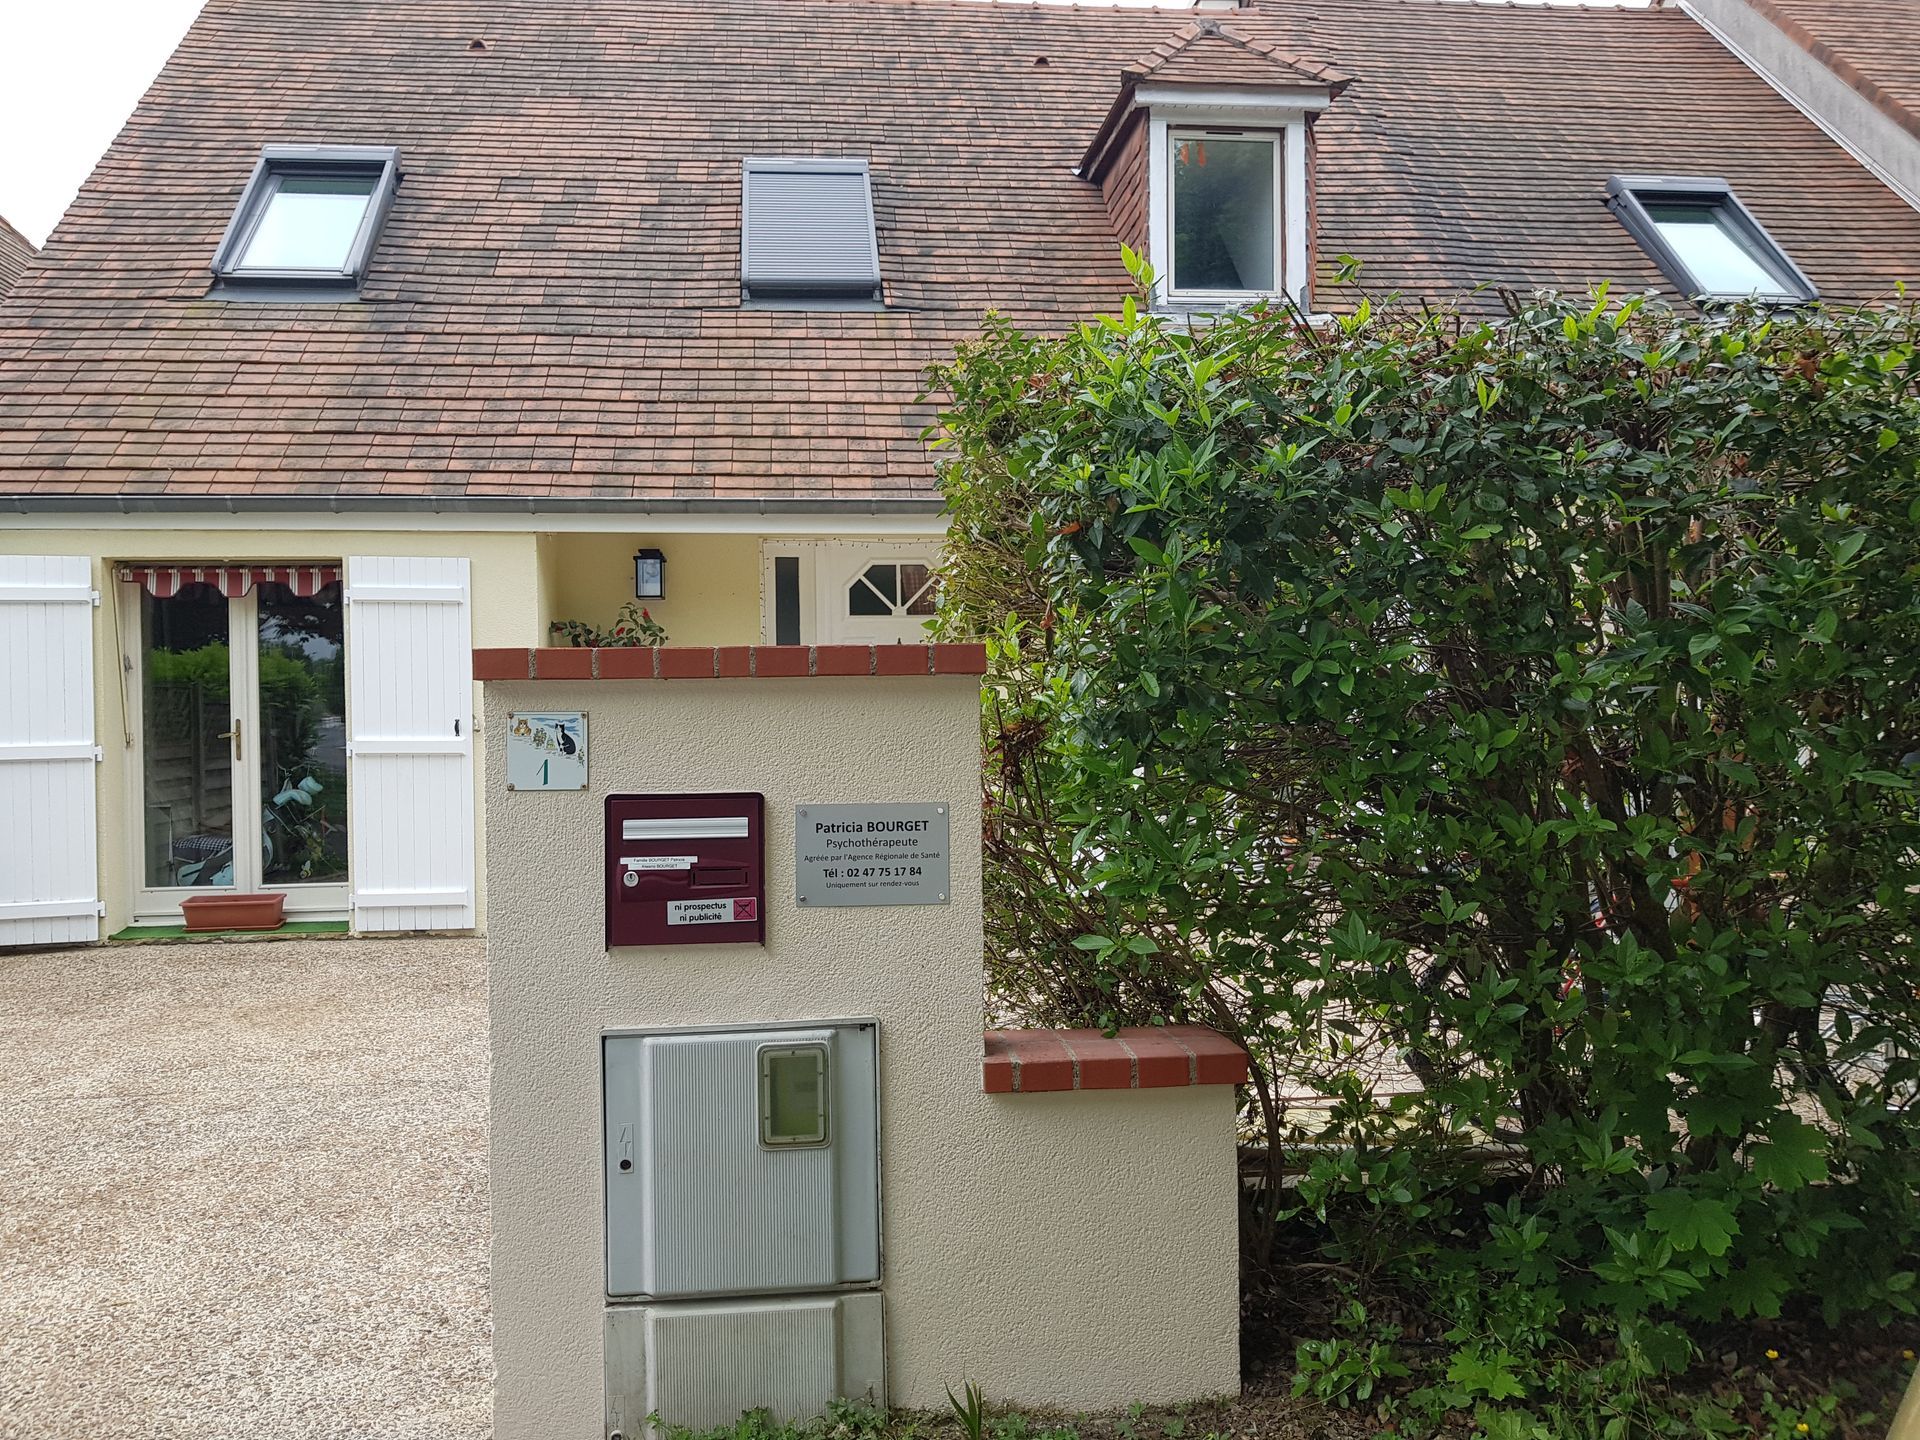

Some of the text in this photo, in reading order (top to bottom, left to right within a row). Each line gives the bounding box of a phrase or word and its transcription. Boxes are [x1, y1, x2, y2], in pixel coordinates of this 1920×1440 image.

[536, 759, 548, 785] 1
[816, 821, 929, 833] Patricia BOURGET
[826, 838, 918, 850] Psychothérapeute
[875, 853, 908, 861] Régionale
[823, 868, 837, 878] Tél
[847, 869, 859, 877] 02
[863, 868, 875, 877] 47
[879, 868, 890, 876] 75
[895, 867, 905, 876] 17
[909, 867, 921, 876] 84
[675, 903, 727, 912] ni prospectus
[689, 913, 722, 922] publicité
